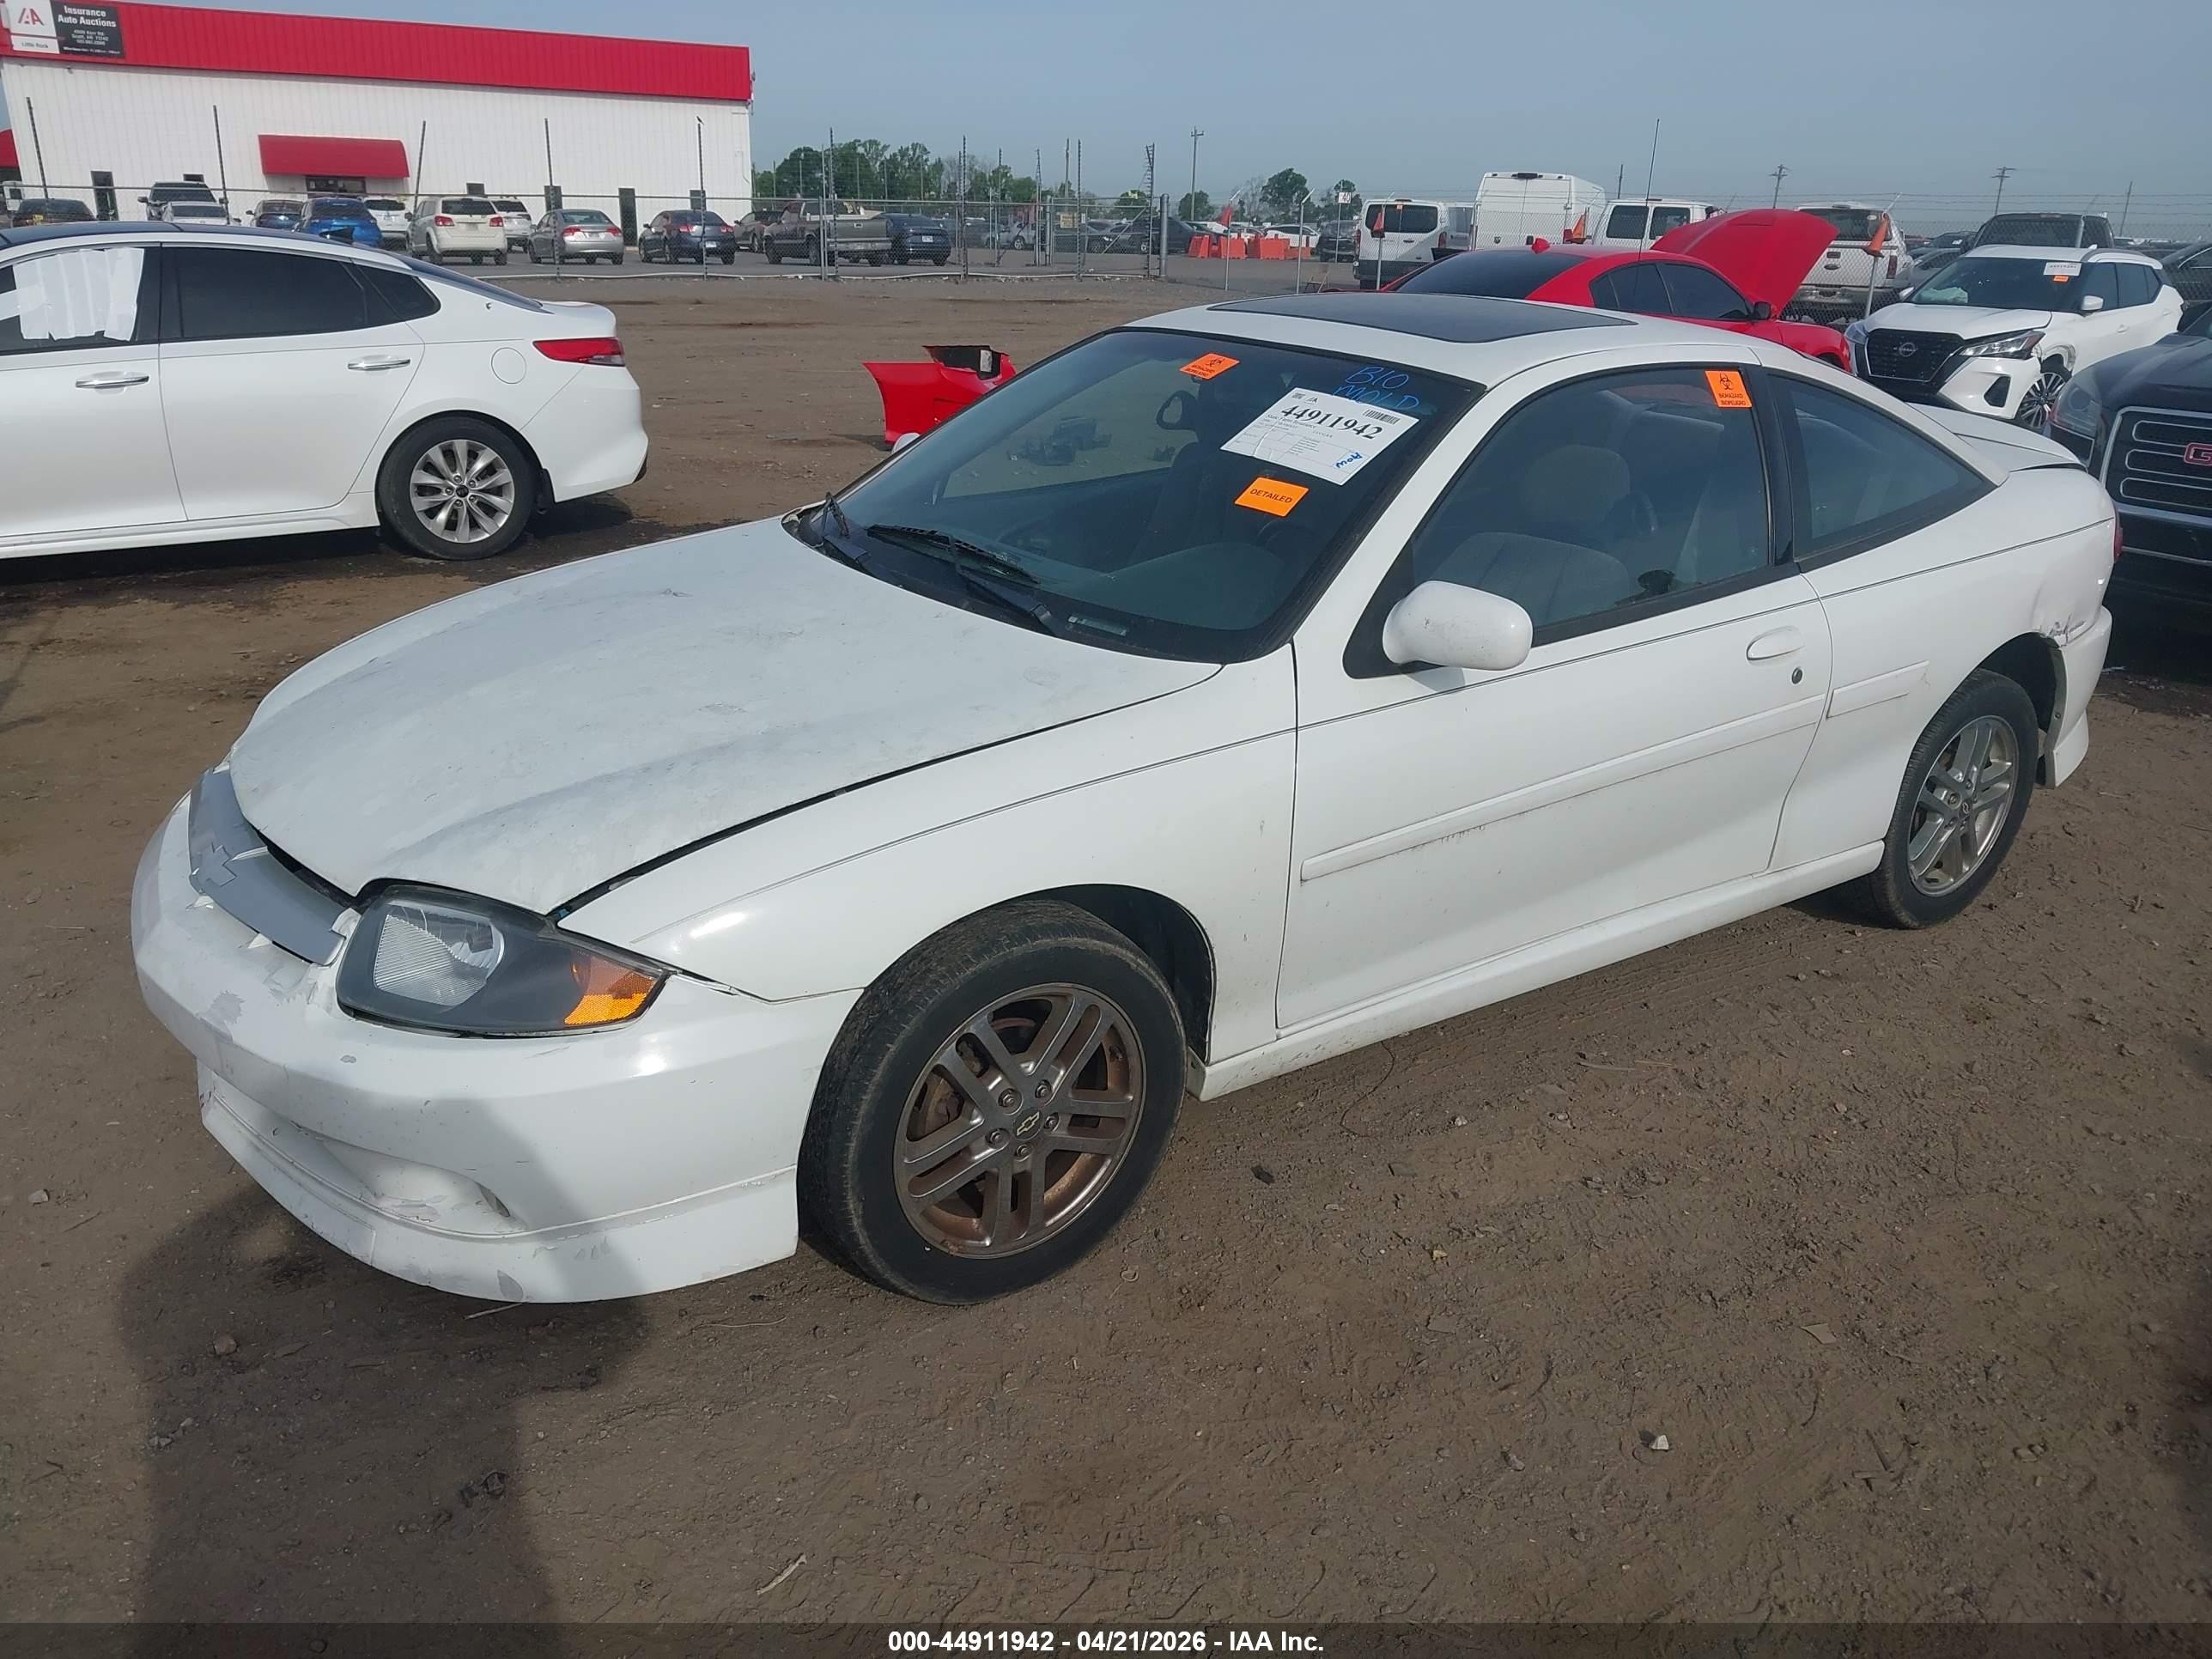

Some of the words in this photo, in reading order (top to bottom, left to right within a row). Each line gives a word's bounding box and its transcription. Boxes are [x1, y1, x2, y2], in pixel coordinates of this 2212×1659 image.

[64, 5, 106, 17] Insurance
[58, 15, 78, 24] Auto
[80, 16, 117, 27] Auctions
[1345, 367, 1409, 389] BIO
[1280, 404, 1383, 440] 44911942
[1250, 489, 1292, 503] DETAILED
